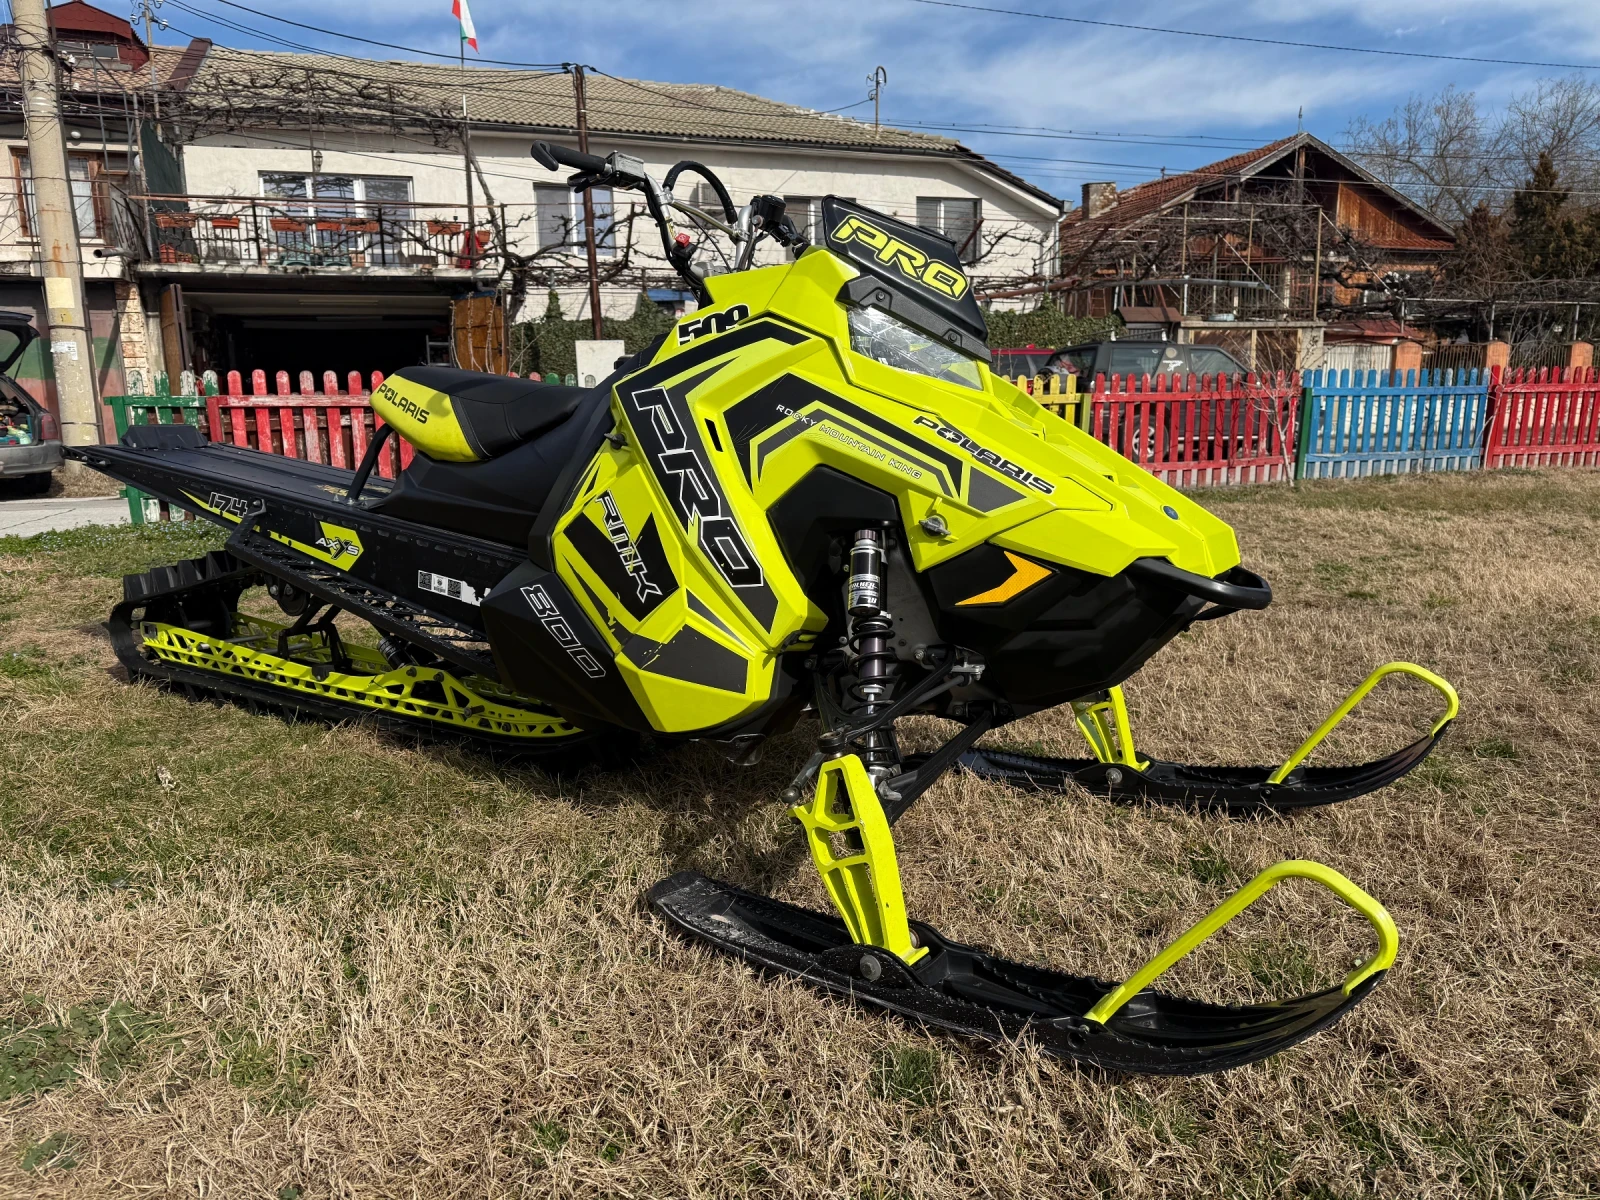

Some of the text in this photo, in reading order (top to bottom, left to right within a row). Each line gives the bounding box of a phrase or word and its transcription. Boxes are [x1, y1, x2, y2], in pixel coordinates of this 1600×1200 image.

[830, 214, 970, 301] PRO
[377, 382, 430, 424] POLARIS
[775, 403, 923, 480] ROCKY MOUNTAIN KING
[631, 383, 764, 588] PRO
[912, 414, 1057, 496] POLARIS
[207, 491, 249, 518] 174
[595, 489, 664, 604] RMK
[520, 584, 607, 679] 800
